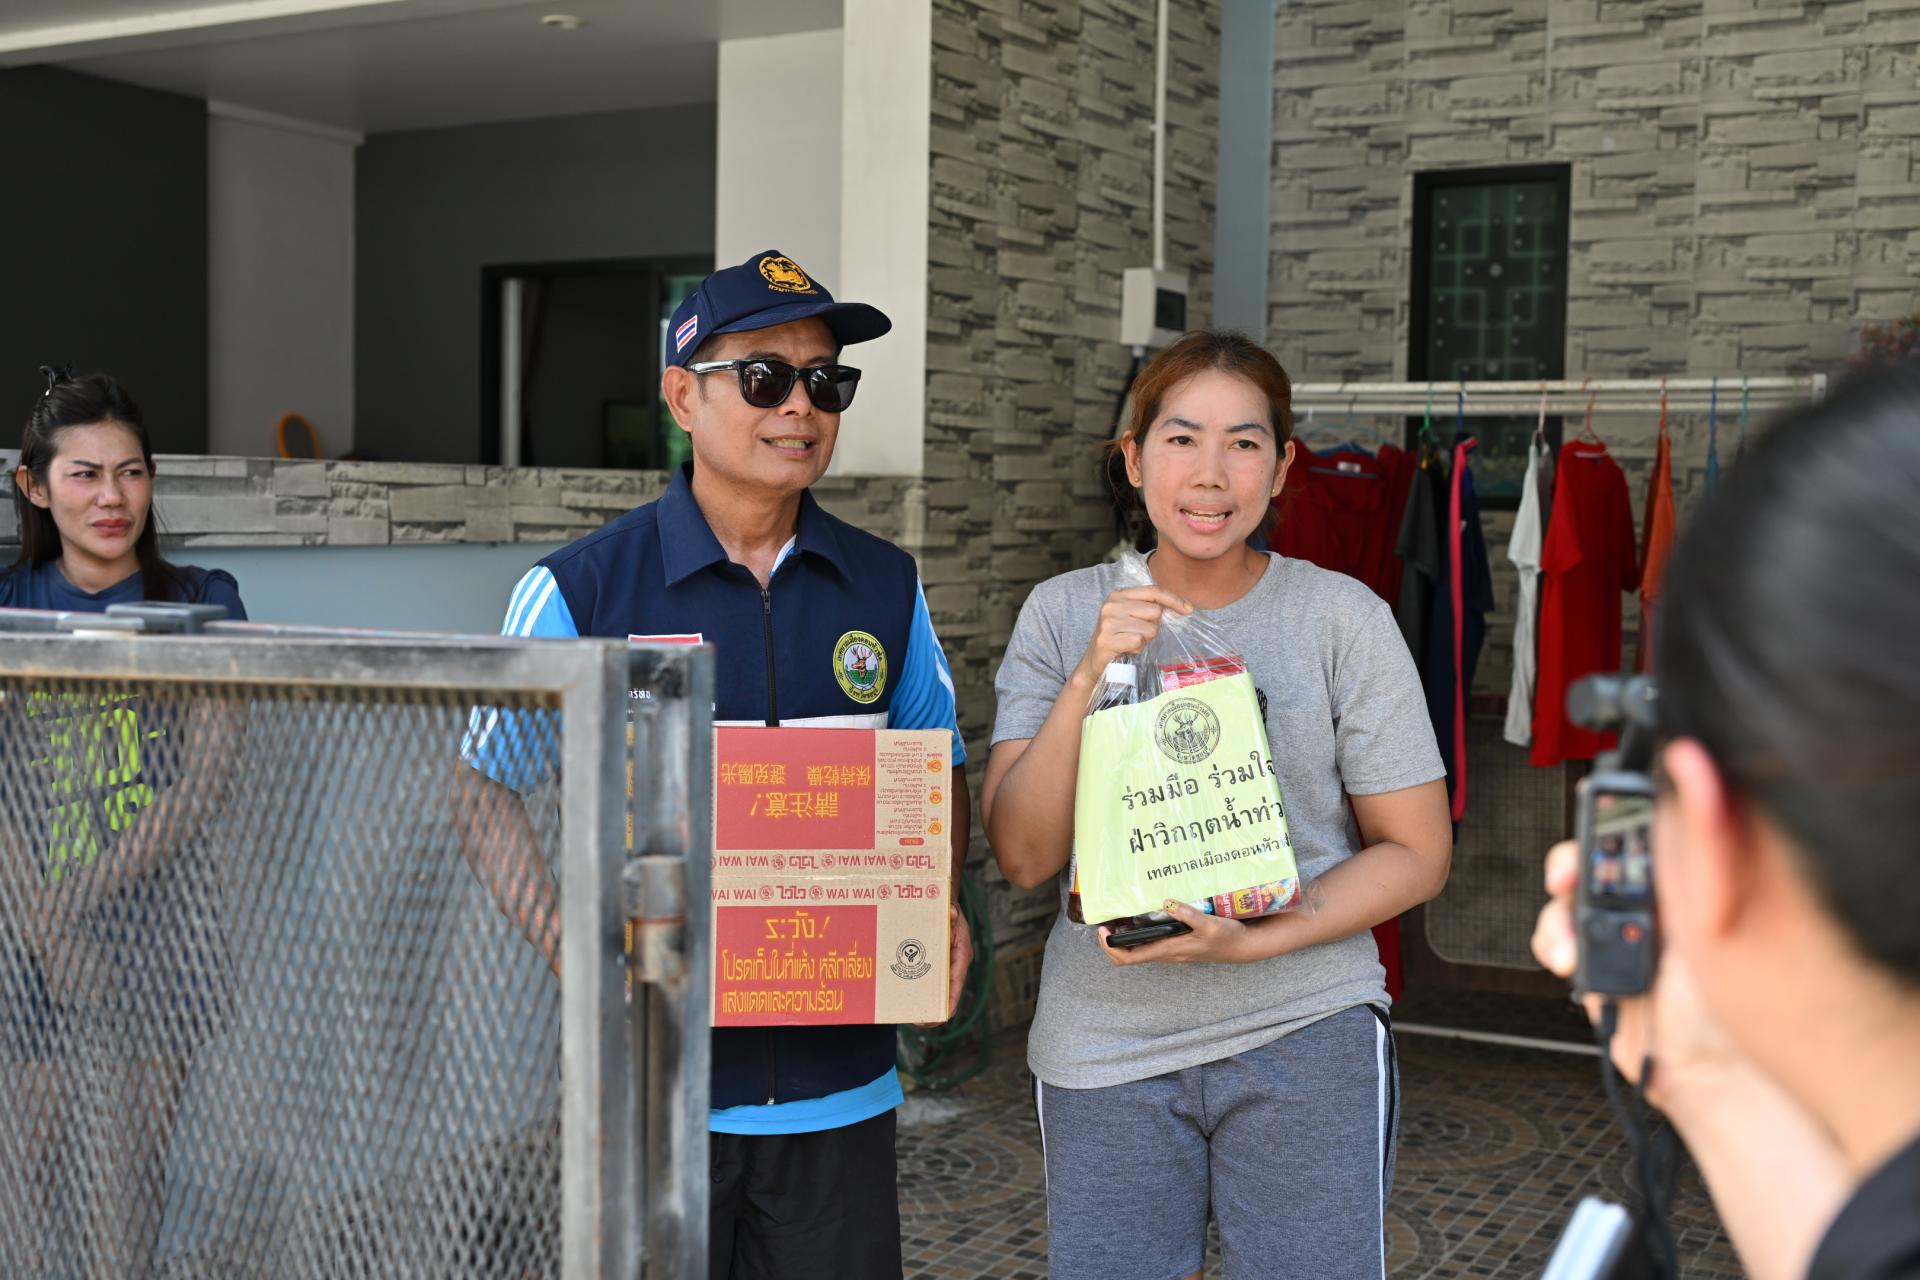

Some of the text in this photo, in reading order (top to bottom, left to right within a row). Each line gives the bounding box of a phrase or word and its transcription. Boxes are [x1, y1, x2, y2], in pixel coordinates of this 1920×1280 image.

[720, 763, 872, 787] 保持乾燥 避免陽光
[1121, 772, 1200, 810] ร่วมมือ
[719, 855, 742, 866] WAI
[746, 855, 769, 866] WAI
[838, 855, 861, 866] WAI
[864, 855, 887, 866] WAI
[733, 889, 757, 900] WAI
[825, 888, 849, 899] WAI
[852, 888, 875, 899] WAI
[721, 941, 815, 981] โปรดเก็บในที่แห้ง
[819, 940, 873, 979] หลีกเลี่ยง
[722, 981, 844, 1013] แสงแดดและความร้อน
